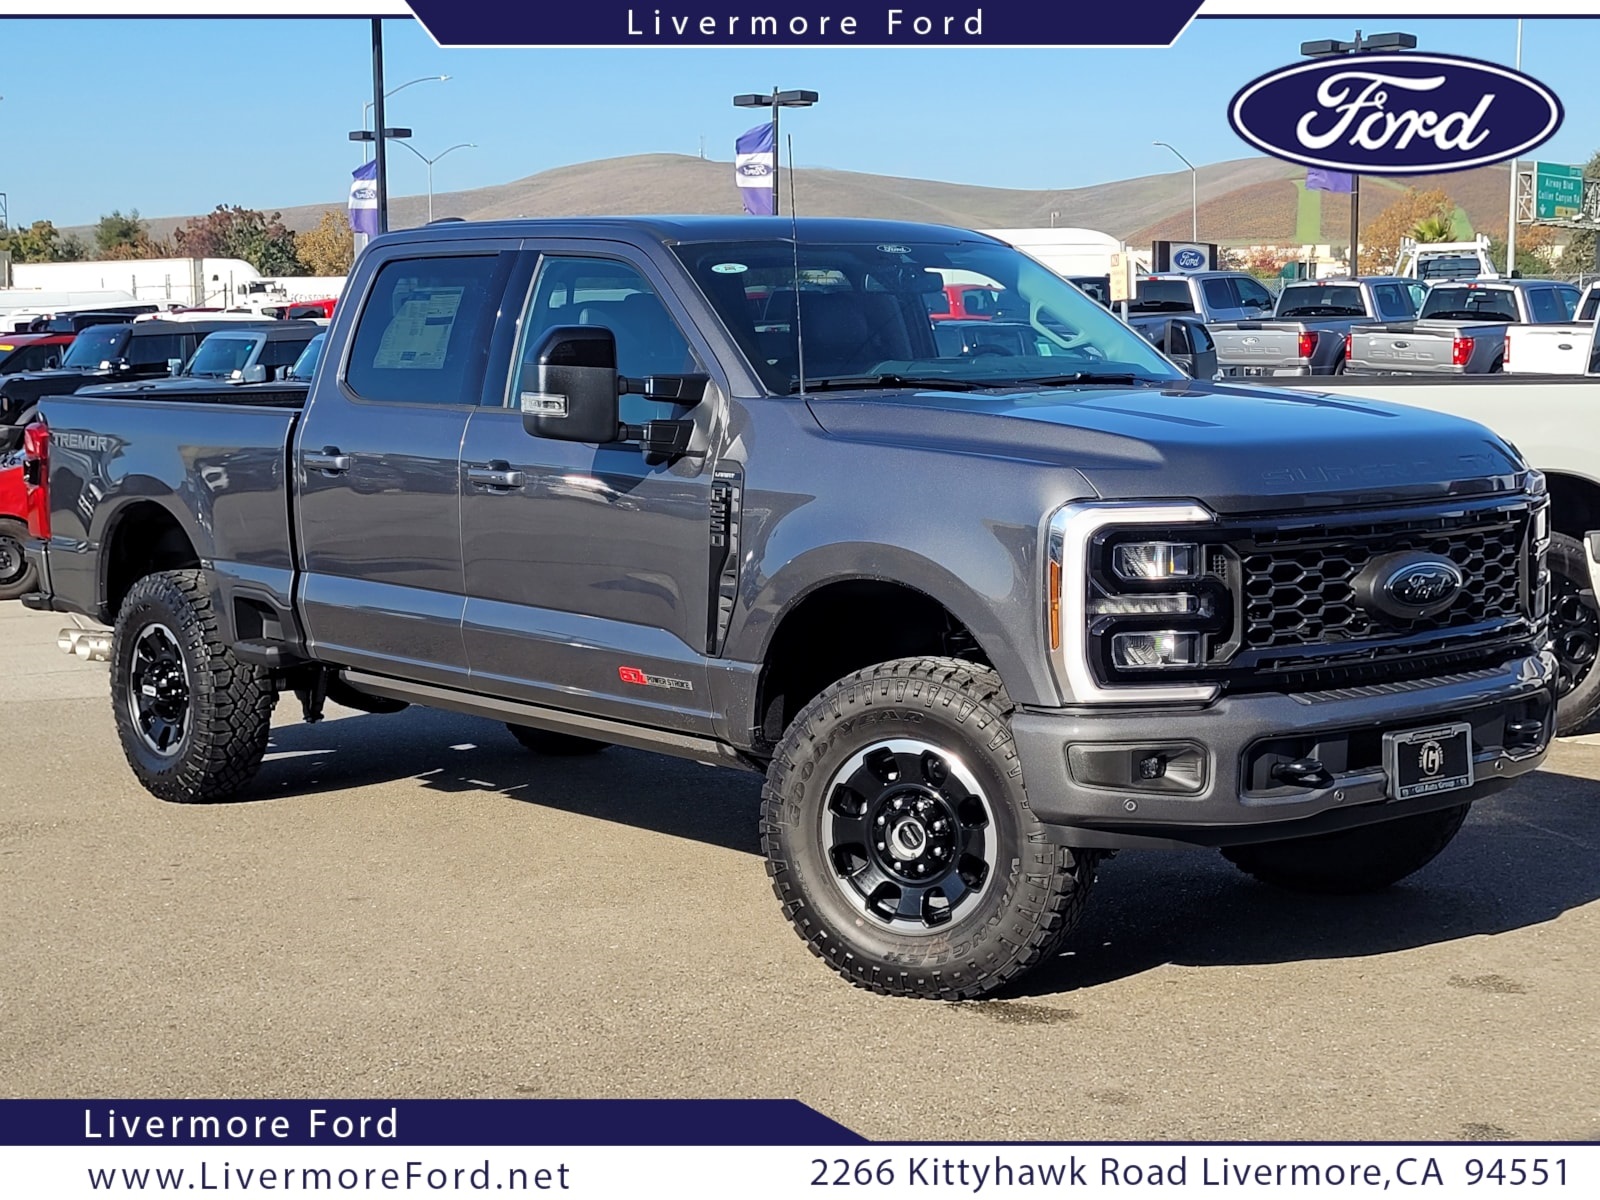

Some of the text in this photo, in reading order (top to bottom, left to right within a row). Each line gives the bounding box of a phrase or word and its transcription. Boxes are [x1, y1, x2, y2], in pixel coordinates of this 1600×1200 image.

[1179, 251, 1200, 266] Ford
[53, 432, 108, 452] TREMOR
[1404, 571, 1454, 599] Ford
